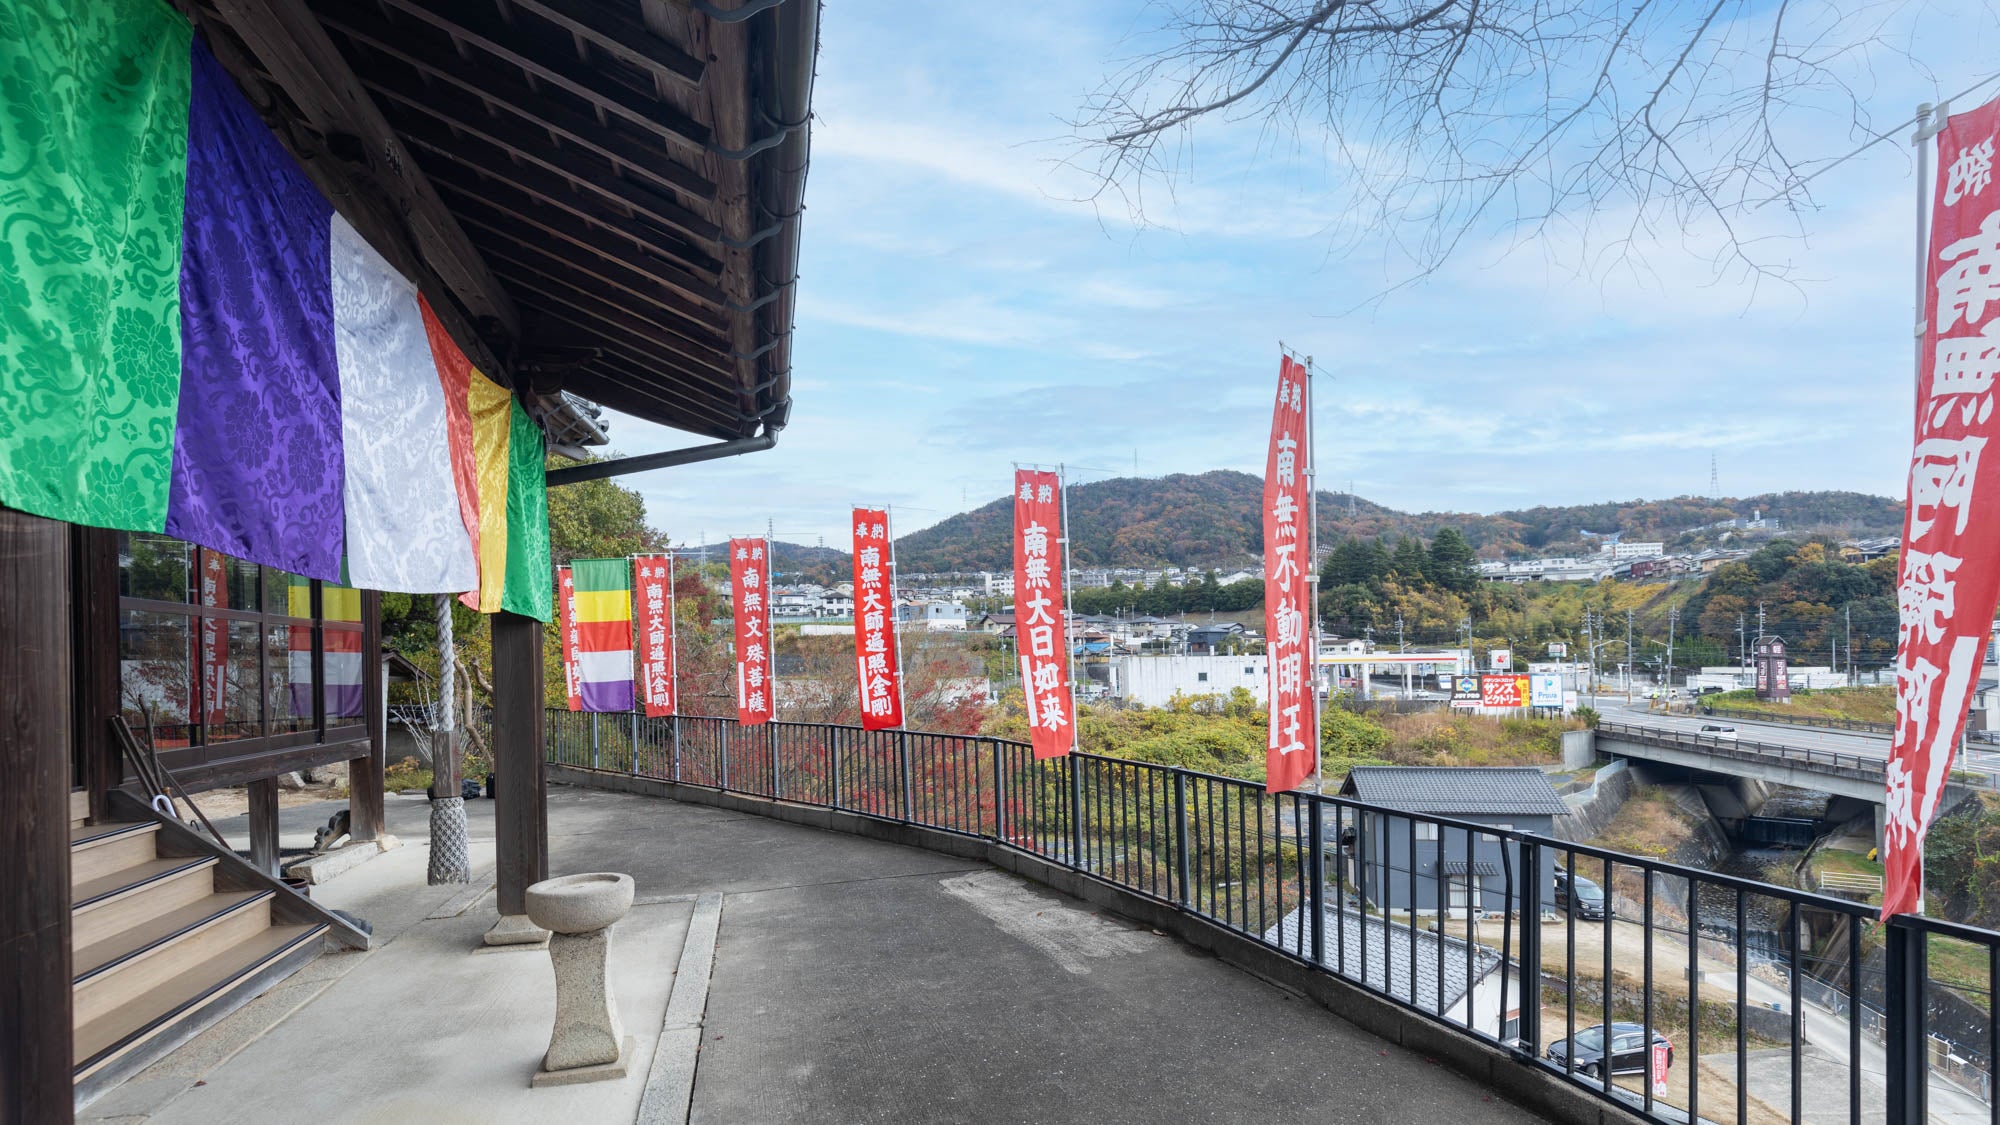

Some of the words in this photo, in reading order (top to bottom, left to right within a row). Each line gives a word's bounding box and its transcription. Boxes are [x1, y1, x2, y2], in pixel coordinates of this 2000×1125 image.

[1279, 376, 1302, 415] 奉納
[1019, 481, 1052, 504] 奉納
[855, 522, 884, 539] 奉納
[735, 547, 763, 561] 奉納
[640, 566, 665, 578] 奉納
[1272, 431, 1306, 756] 南無不動明王
[741, 567, 767, 713] 南無文殊菩薩
[860, 546, 893, 717] 南無大師遍照金剛
[1024, 520, 1068, 732] 南無大日如来
[646, 583, 669, 707] 南無大師遍照金剛
[1484, 683, 1515, 694] サンズ
[1485, 695, 1520, 704] ビクトリー
